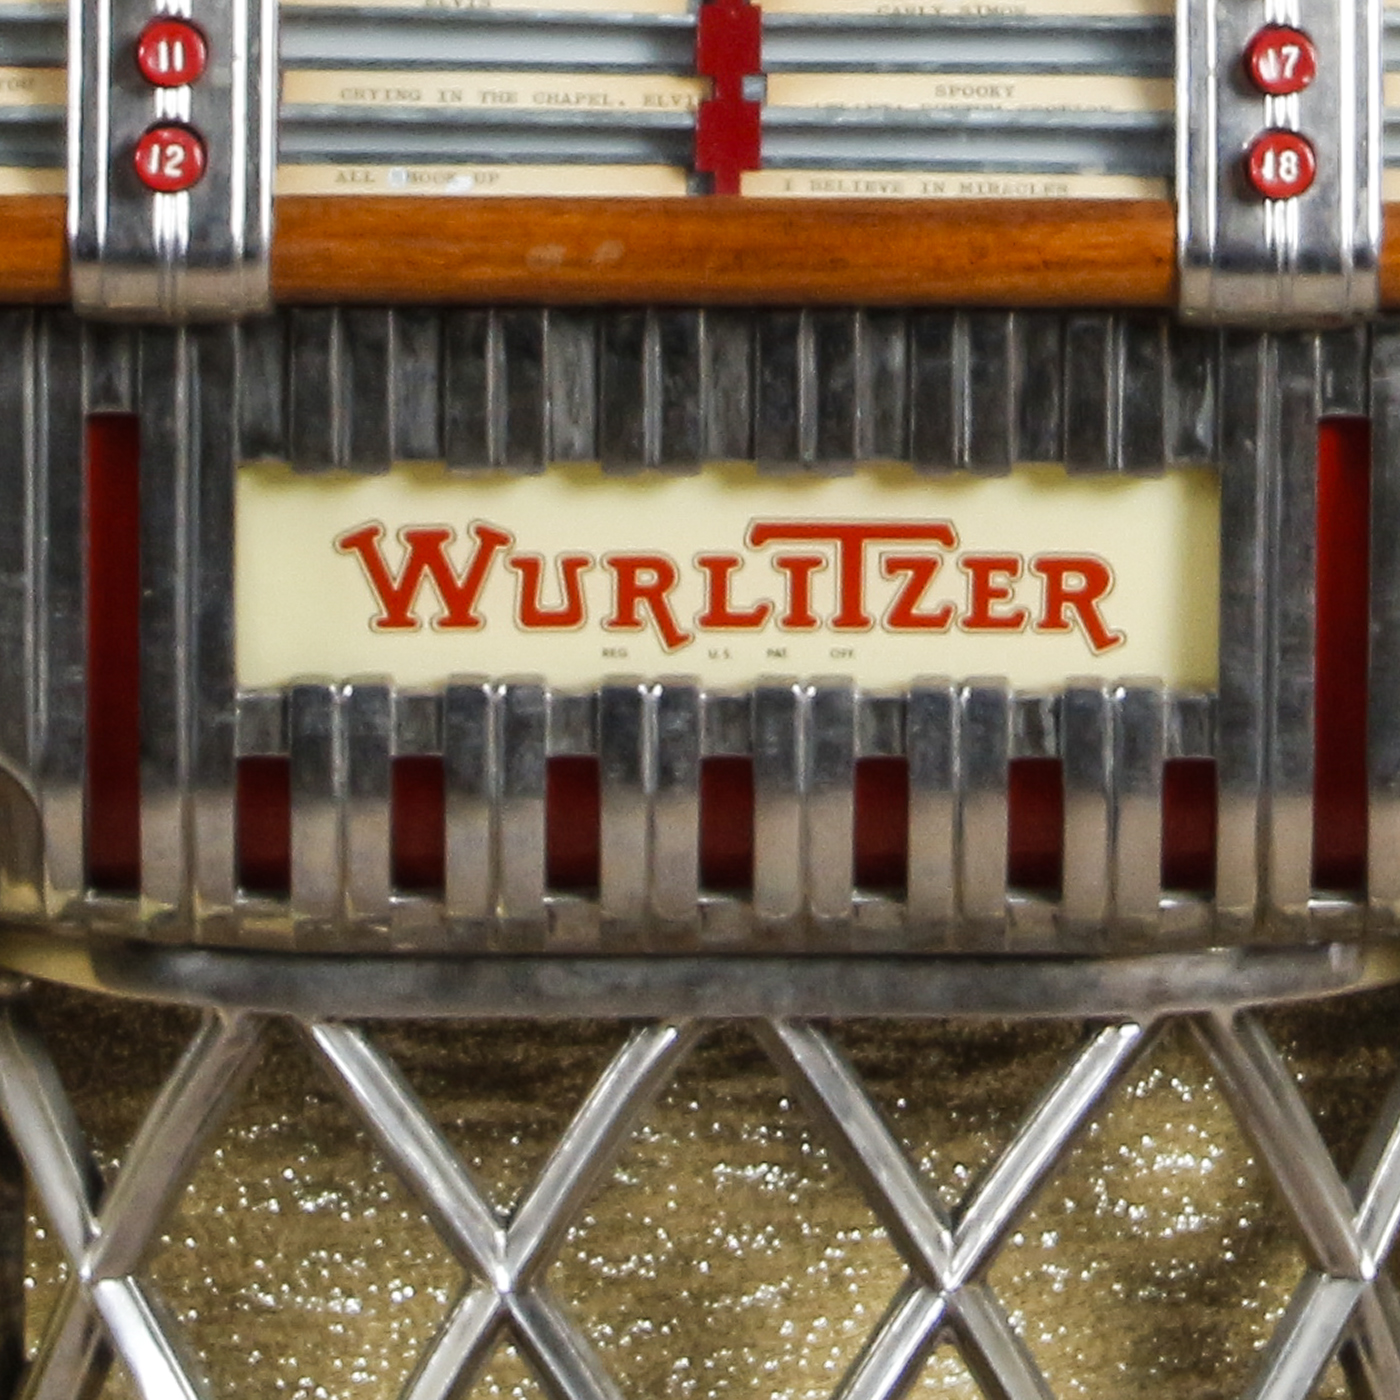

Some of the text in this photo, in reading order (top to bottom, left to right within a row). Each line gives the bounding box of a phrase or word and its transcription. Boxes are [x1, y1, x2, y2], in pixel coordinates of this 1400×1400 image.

[156, 40, 185, 72] 11
[1260, 45, 1299, 79] 17
[340, 88, 421, 101] CRYING
[438, 89, 462, 101] IN
[479, 91, 518, 103] THE
[935, 84, 1016, 98] SPOOKY
[149, 145, 186, 178] 12
[335, 171, 376, 183] ALL
[475, 172, 498, 184] UP
[1261, 149, 1299, 182] 18
[784, 180, 793, 191] I
[810, 180, 898, 192] BELIEVE
[920, 181, 945, 193] IN
[334, 518, 1126, 657] WURLITZER
